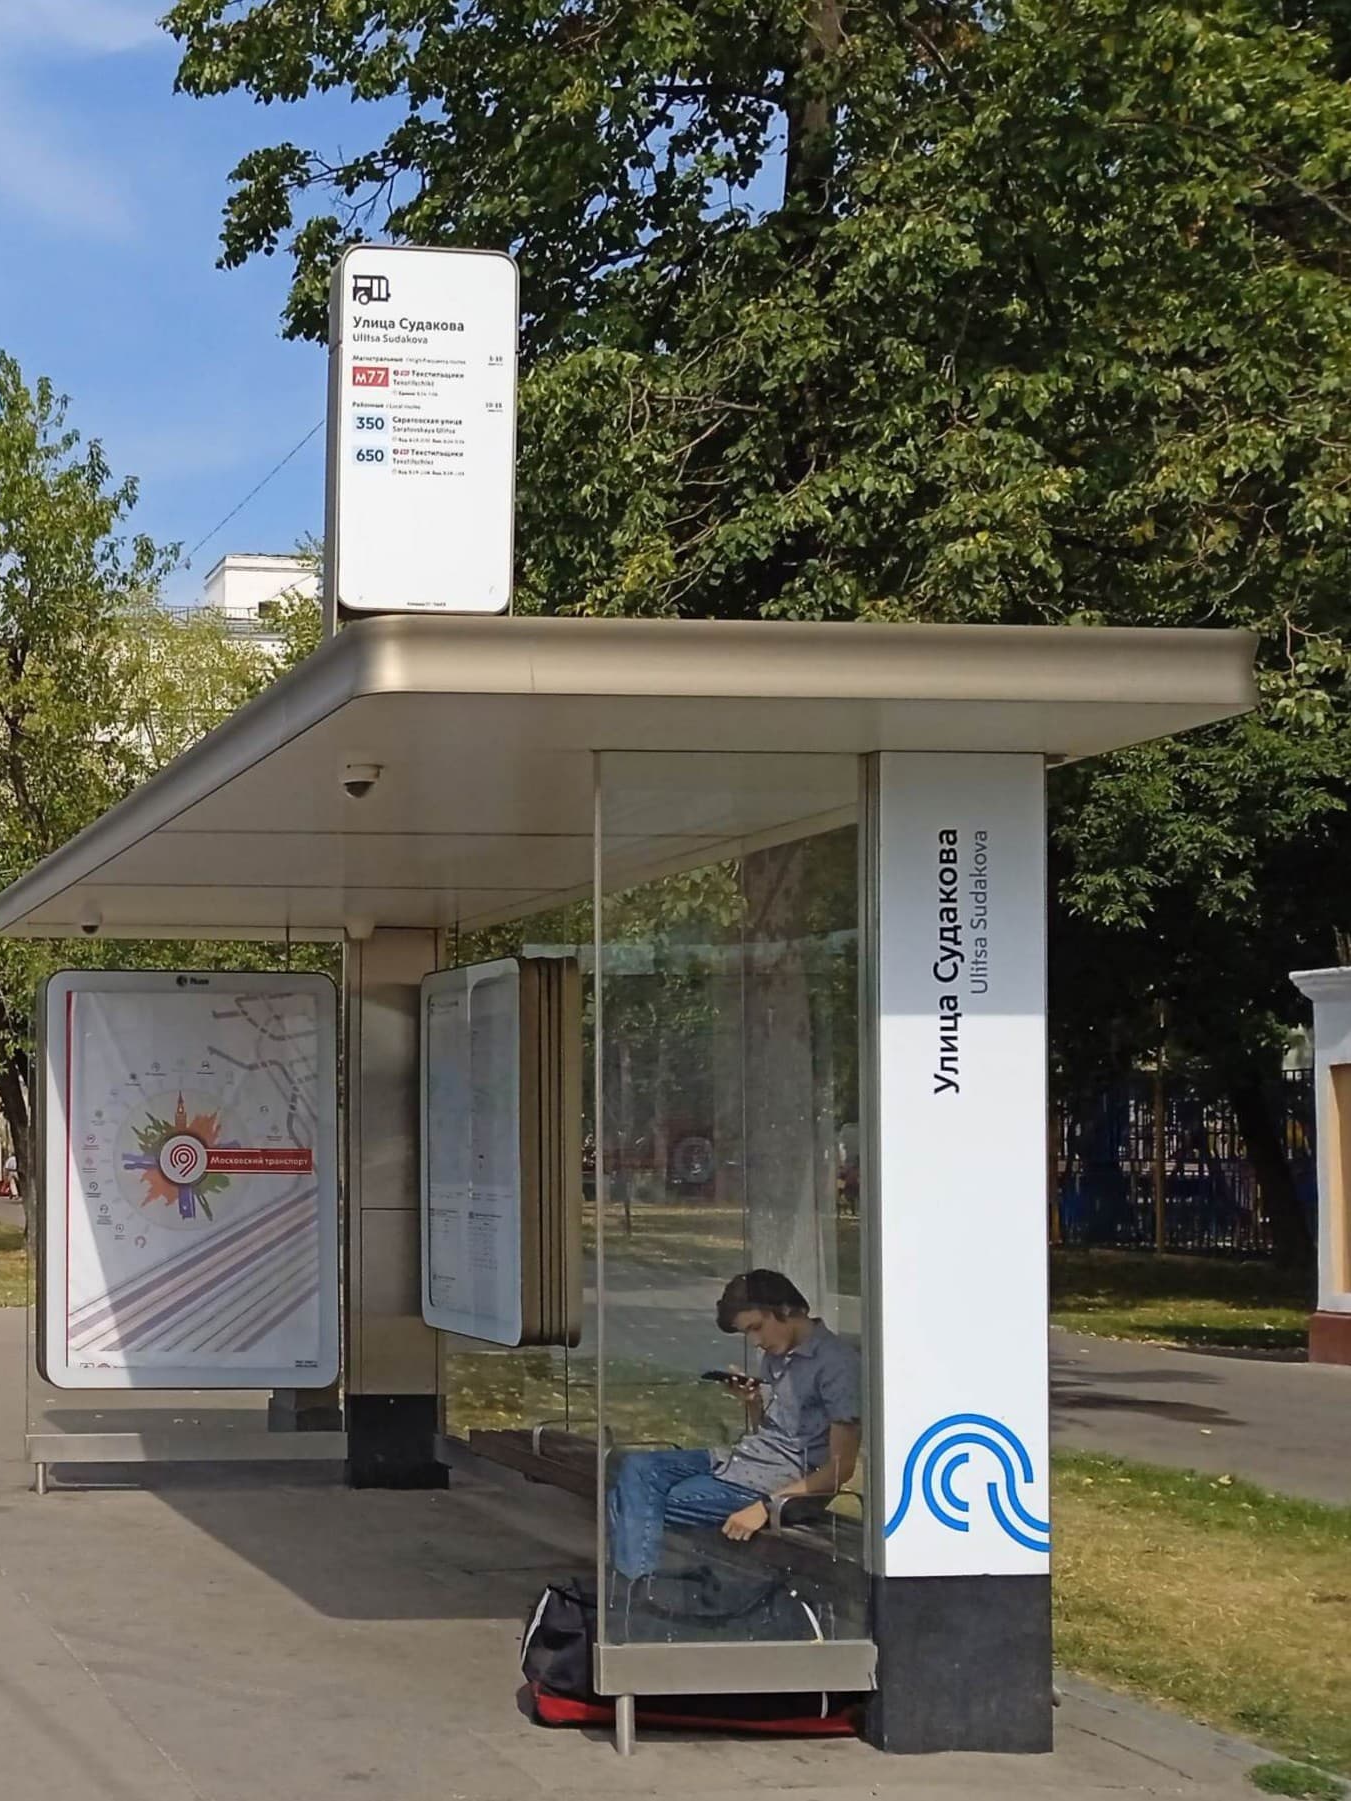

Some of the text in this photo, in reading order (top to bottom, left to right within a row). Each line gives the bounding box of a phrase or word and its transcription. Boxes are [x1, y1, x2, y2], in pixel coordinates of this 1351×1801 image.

[352, 316, 465, 333] Улица Судакова
[352, 333, 428, 344] Ulitsa Sudakova
[356, 417, 385, 430] 350
[356, 449, 384, 462] 650
[969, 830, 988, 994] Ulitsa Sudakova
[933, 828, 965, 1094] Улица Судакова
[210, 1156, 308, 1167] Московский транспорт
